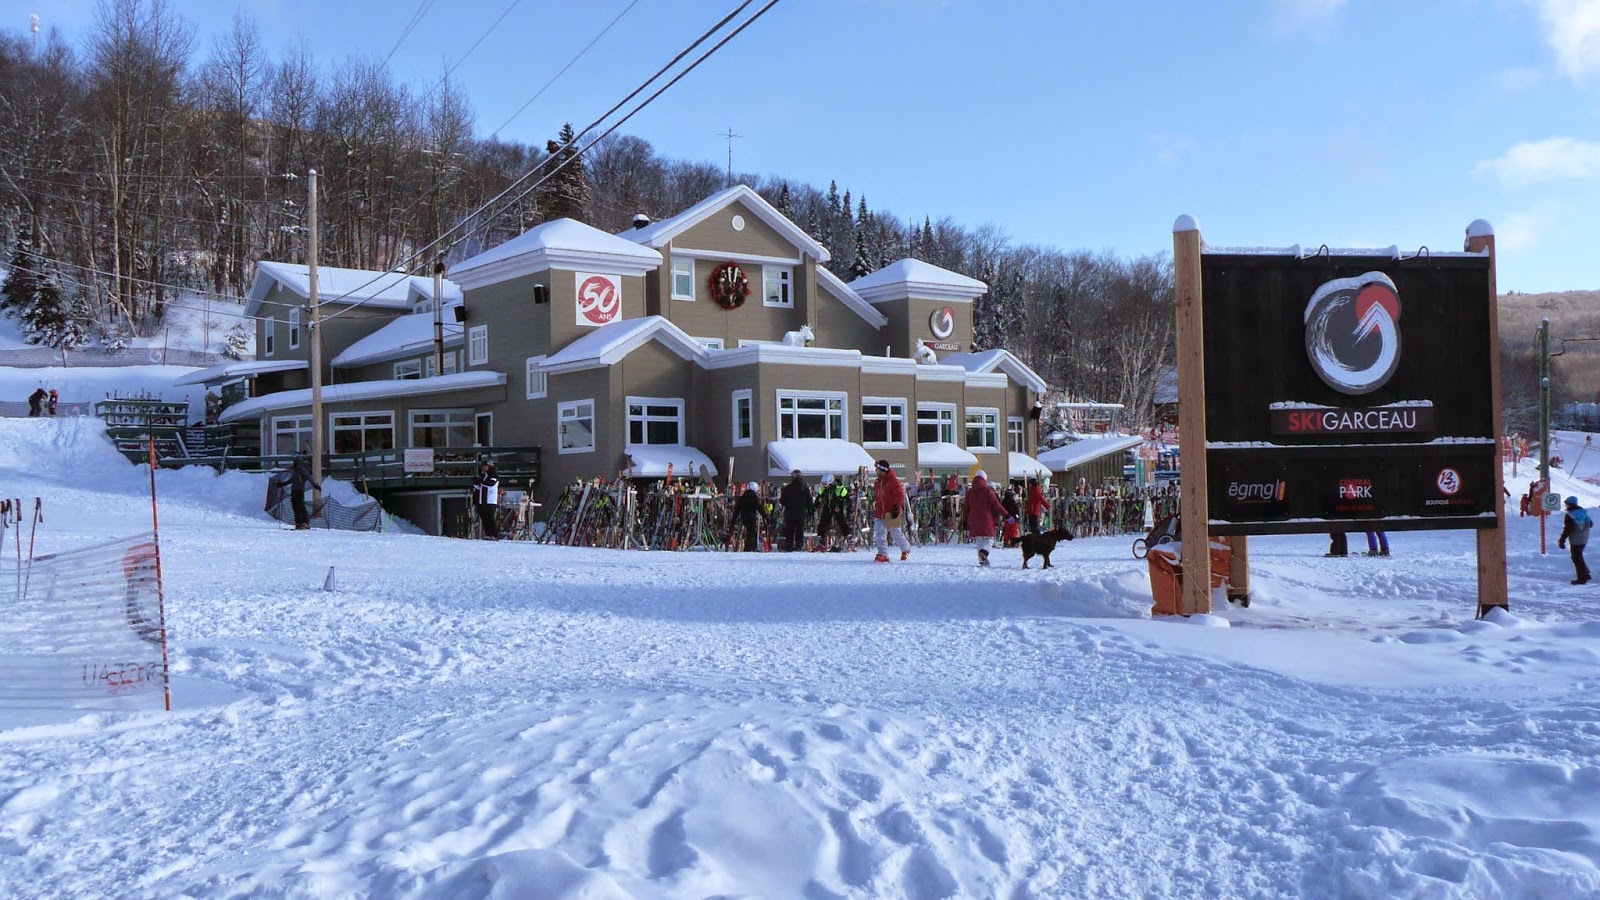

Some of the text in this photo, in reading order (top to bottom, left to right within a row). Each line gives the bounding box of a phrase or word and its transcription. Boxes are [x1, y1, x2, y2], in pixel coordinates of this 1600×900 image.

[582, 282, 618, 313] 50
[934, 343, 958, 351] GARCEAU
[1339, 484, 1372, 499] PARK
